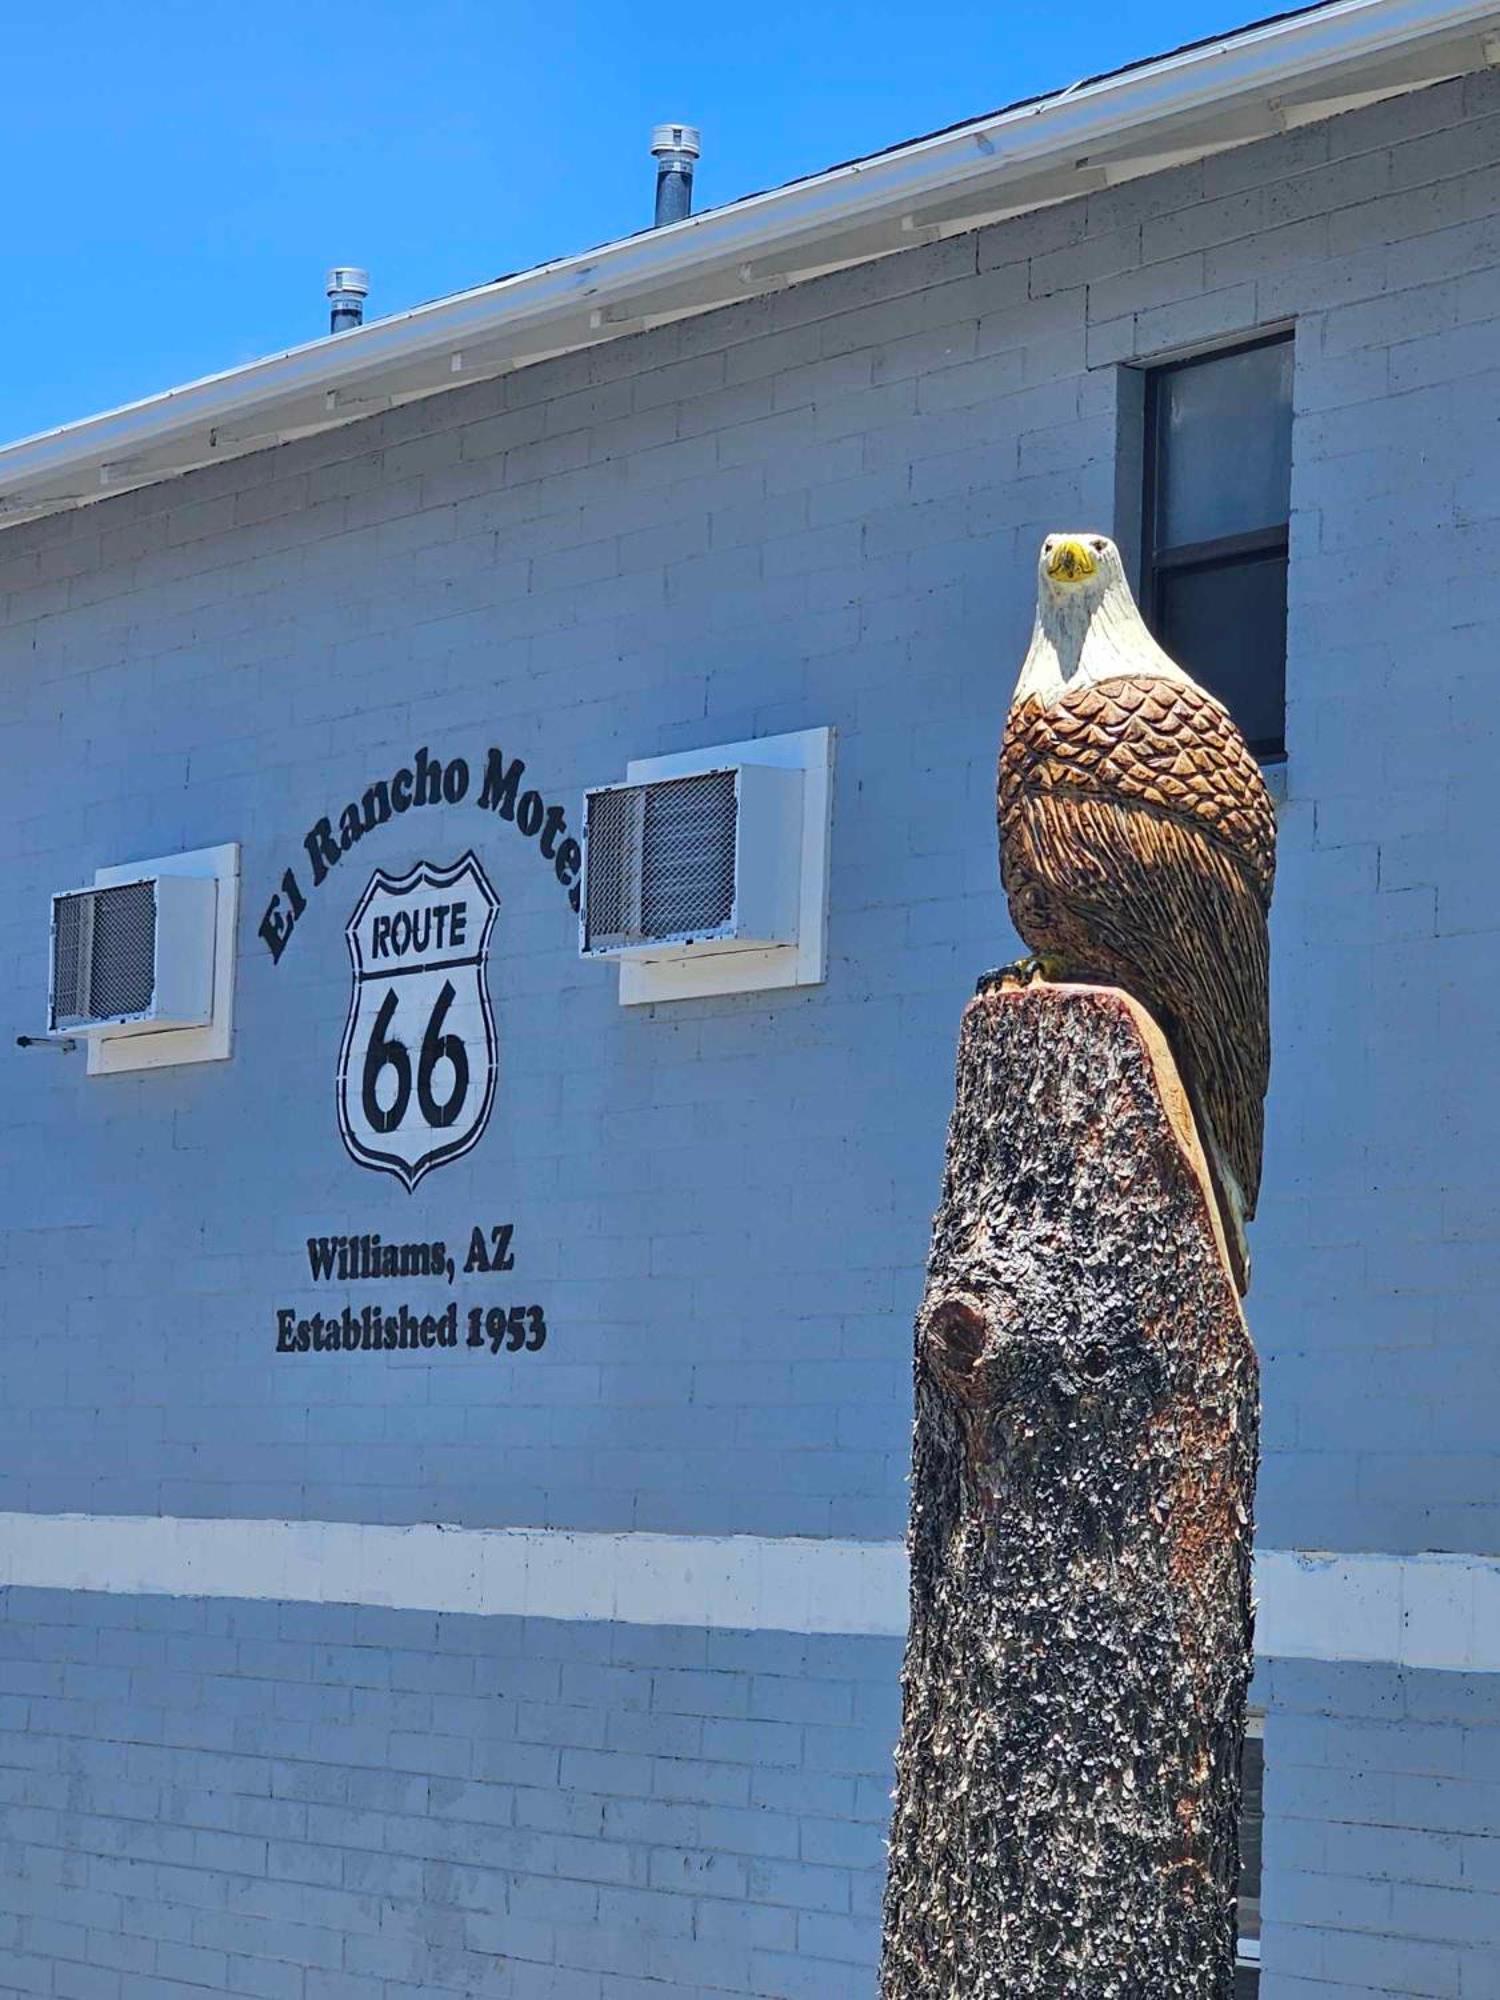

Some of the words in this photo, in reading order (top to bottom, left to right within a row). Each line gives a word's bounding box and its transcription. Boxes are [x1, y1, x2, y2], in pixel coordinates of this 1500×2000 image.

[258, 867, 306, 965] El
[304, 746, 469, 886] Rancho
[371, 901, 467, 959] ROUTE
[362, 978, 469, 1133] 66
[306, 1234, 455, 1285] Williams,
[463, 1223, 515, 1273] AZ
[275, 1302, 458, 1353] Established
[465, 1304, 547, 1354] 1953
